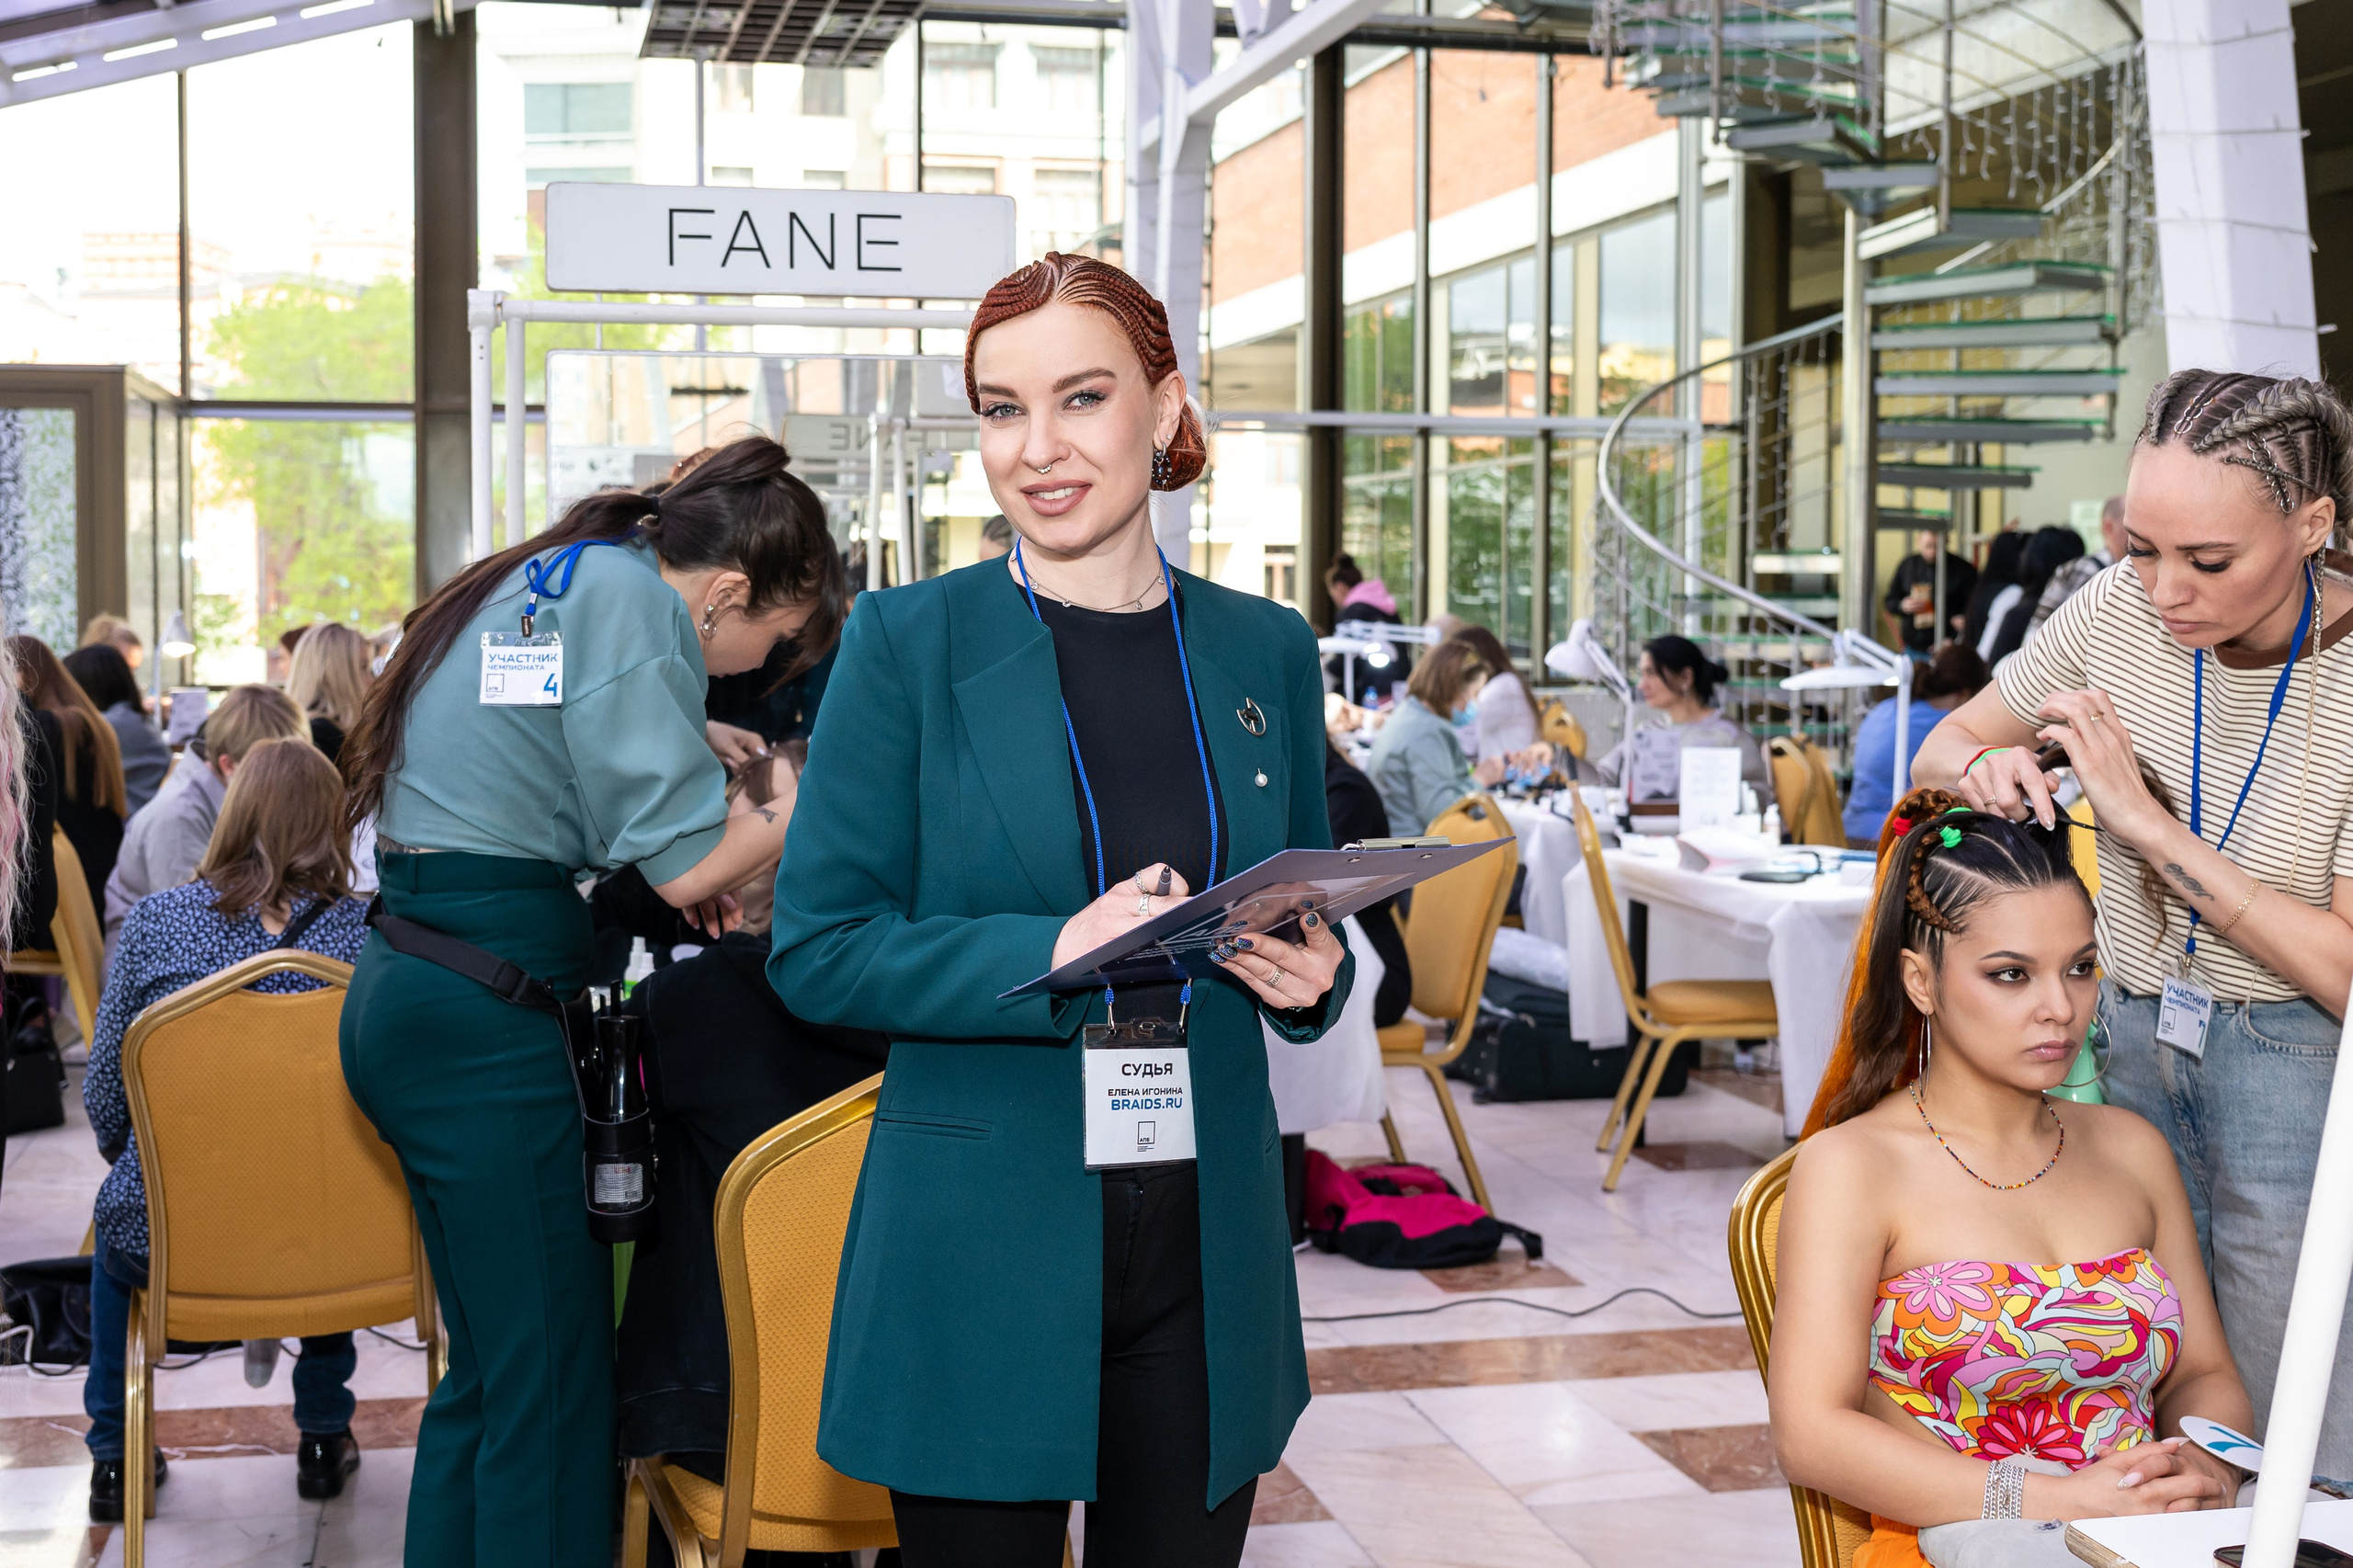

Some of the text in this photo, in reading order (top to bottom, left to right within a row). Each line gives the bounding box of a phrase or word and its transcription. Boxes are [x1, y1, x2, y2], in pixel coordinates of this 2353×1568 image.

[669, 208, 903, 272] FANE
[488, 653, 558, 663] УЧАСТНИК
[543, 673, 558, 698] 4
[2165, 995, 2201, 1016] ЧЕМПИОНАТА
[2166, 983, 2210, 1010] УЧАСТНИК
[1121, 1062, 1174, 1078] СУДЬЯ
[1108, 1086, 1183, 1096] ЕЛЕНА ИГОНИНА
[1111, 1097, 1183, 1111] BRAIDS.RU
